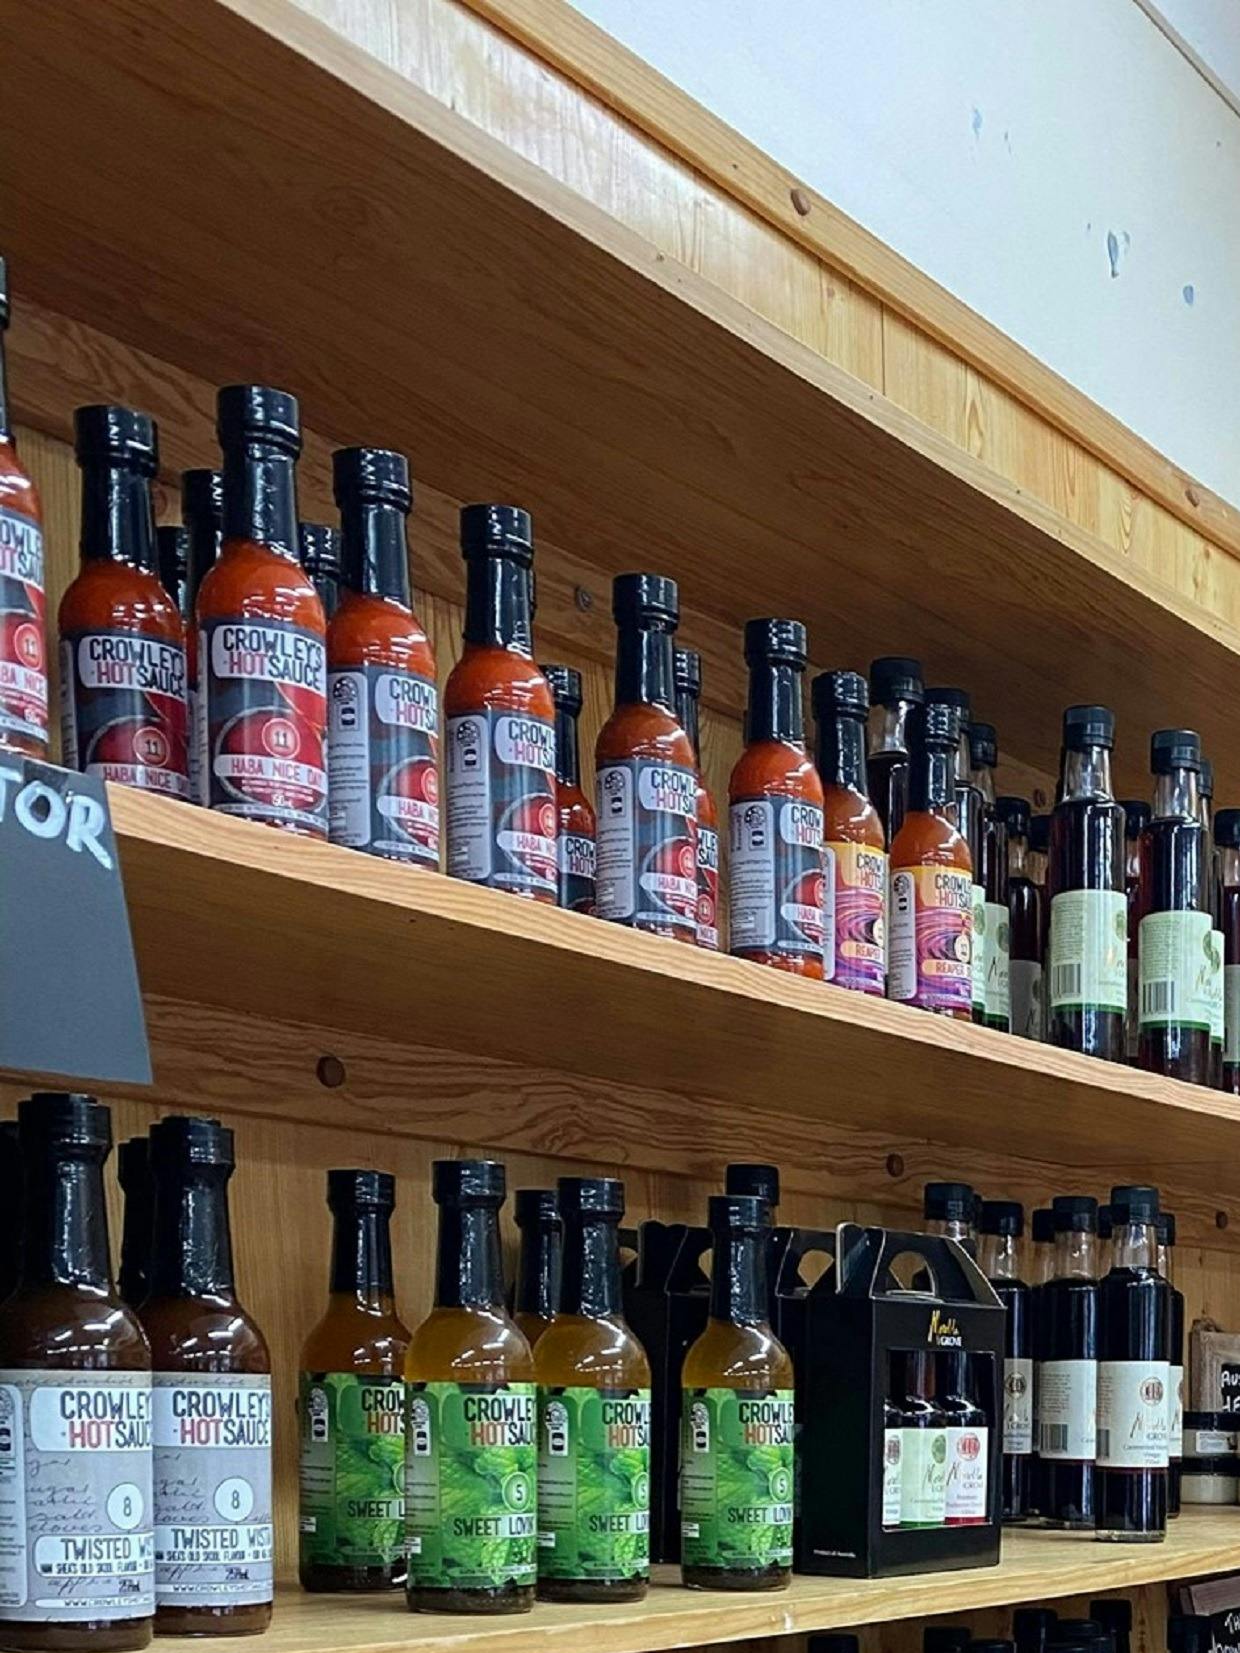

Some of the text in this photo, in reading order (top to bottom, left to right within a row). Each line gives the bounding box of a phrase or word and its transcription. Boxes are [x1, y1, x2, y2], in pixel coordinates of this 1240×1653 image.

[143, 738, 162, 757] 11
[274, 731, 290, 749] 11
[144, 768, 172, 790] NICE
[231, 759, 263, 776] HABA
[272, 763, 300, 781] NICE
[515, 1483, 524, 1501] 5
[778, 1479, 787, 1495] 5
[123, 1496, 132, 1519] 8
[231, 1489, 241, 1511] 8
[349, 1501, 391, 1518] SWEET
[589, 1514, 630, 1534] SWEET
[727, 1506, 768, 1525] SWEET
[453, 1519, 502, 1537] SWEET
[172, 1528, 239, 1551] TWISTED
[60, 1537, 132, 1562] TWISTED
